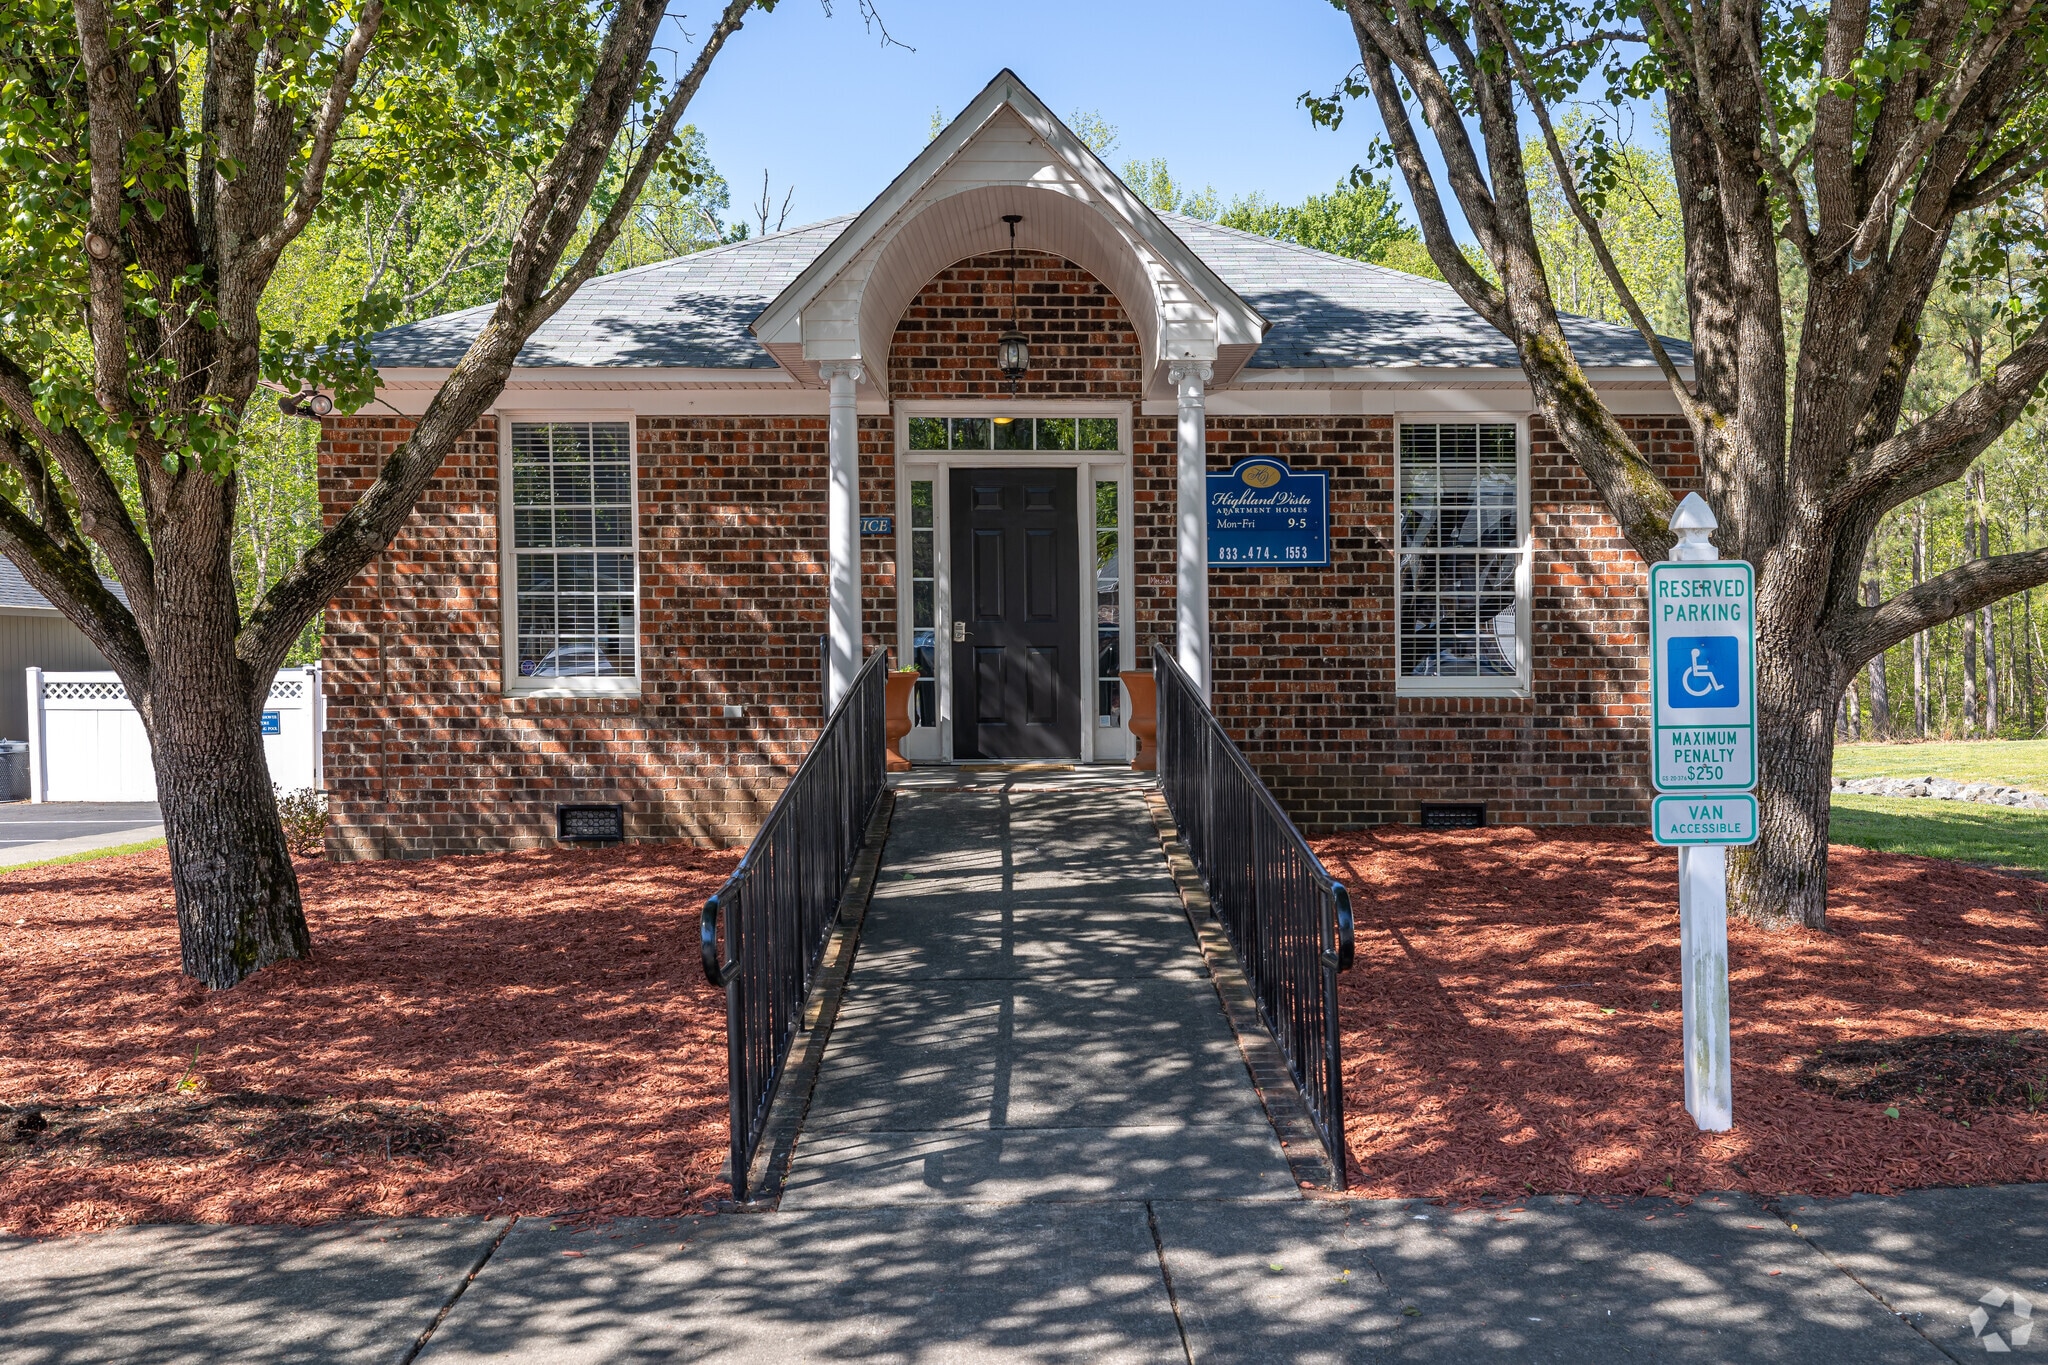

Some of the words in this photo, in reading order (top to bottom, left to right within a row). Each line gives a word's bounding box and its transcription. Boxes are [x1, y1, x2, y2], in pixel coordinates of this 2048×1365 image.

[1211, 488, 1278, 508] Highland
[1278, 492, 1312, 506] Vista
[1216, 507, 1271, 516] APARTMENT
[860, 520, 888, 532] ICE
[1216, 518, 1256, 528] Mon-Fri
[1659, 579, 1745, 598] RESERVED
[1664, 604, 1741, 622] PARKING
[1672, 731, 1737, 746] MAXIMUM
[1674, 748, 1735, 763] PENALTY
[1688, 766, 1723, 782] $250
[1688, 805, 1723, 820] VAN
[1670, 823, 1741, 834] ACCESSIBLE
